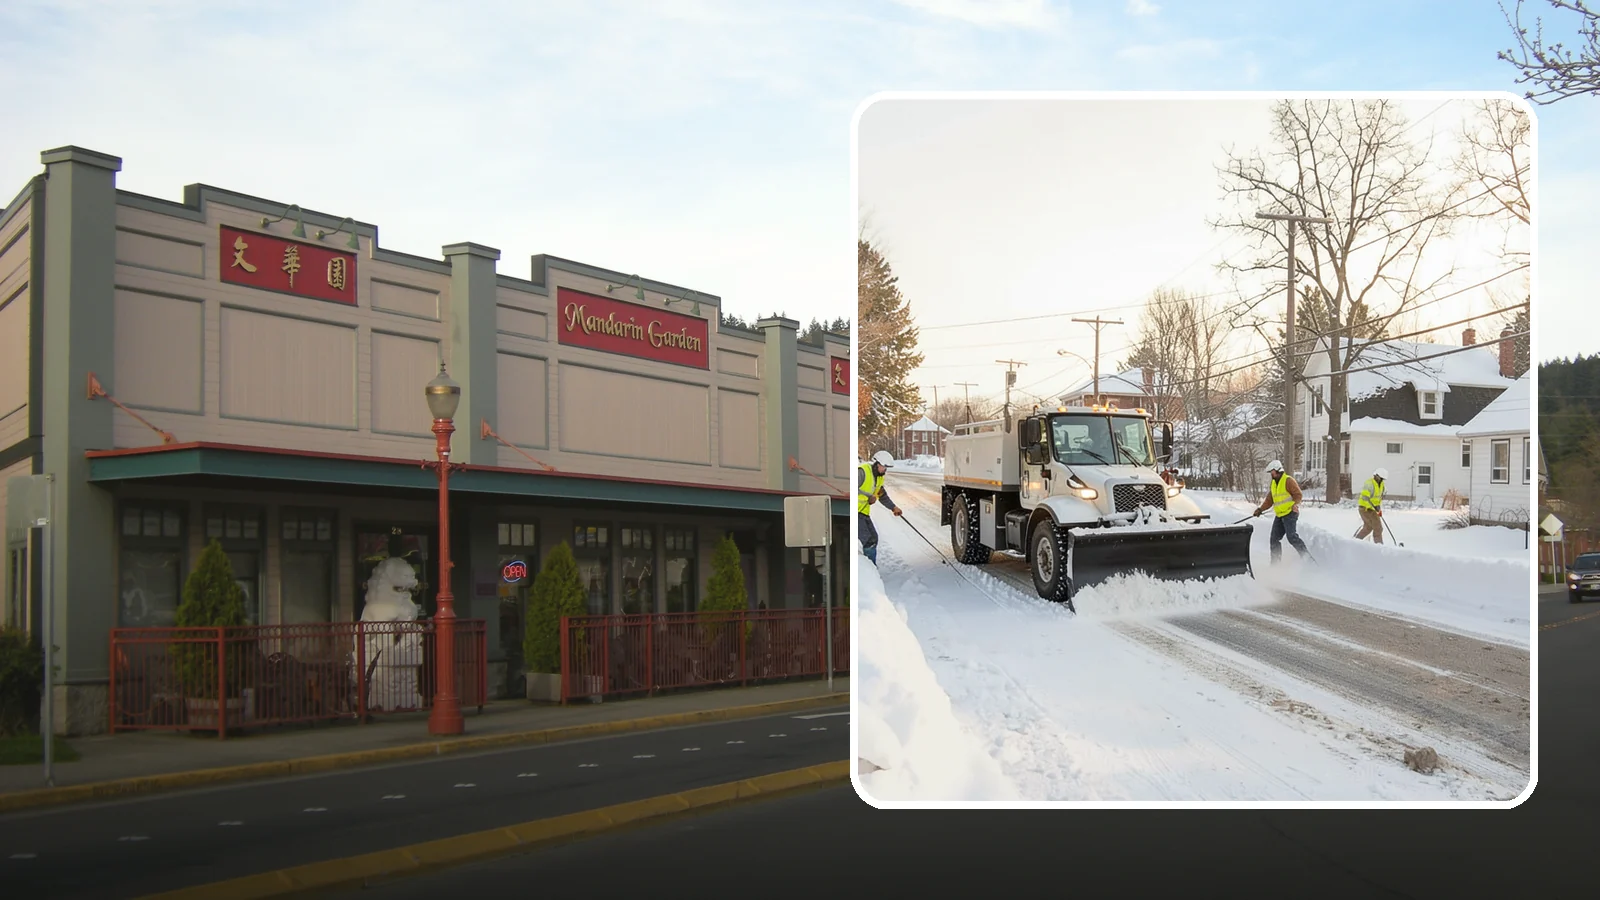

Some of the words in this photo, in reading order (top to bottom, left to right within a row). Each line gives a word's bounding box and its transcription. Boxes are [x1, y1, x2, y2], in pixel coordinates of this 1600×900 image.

[564, 302, 644, 341] Mandarin
[648, 320, 701, 352] Garden
[834, 363, 846, 386] 文
[503, 565, 527, 578] OPEN
